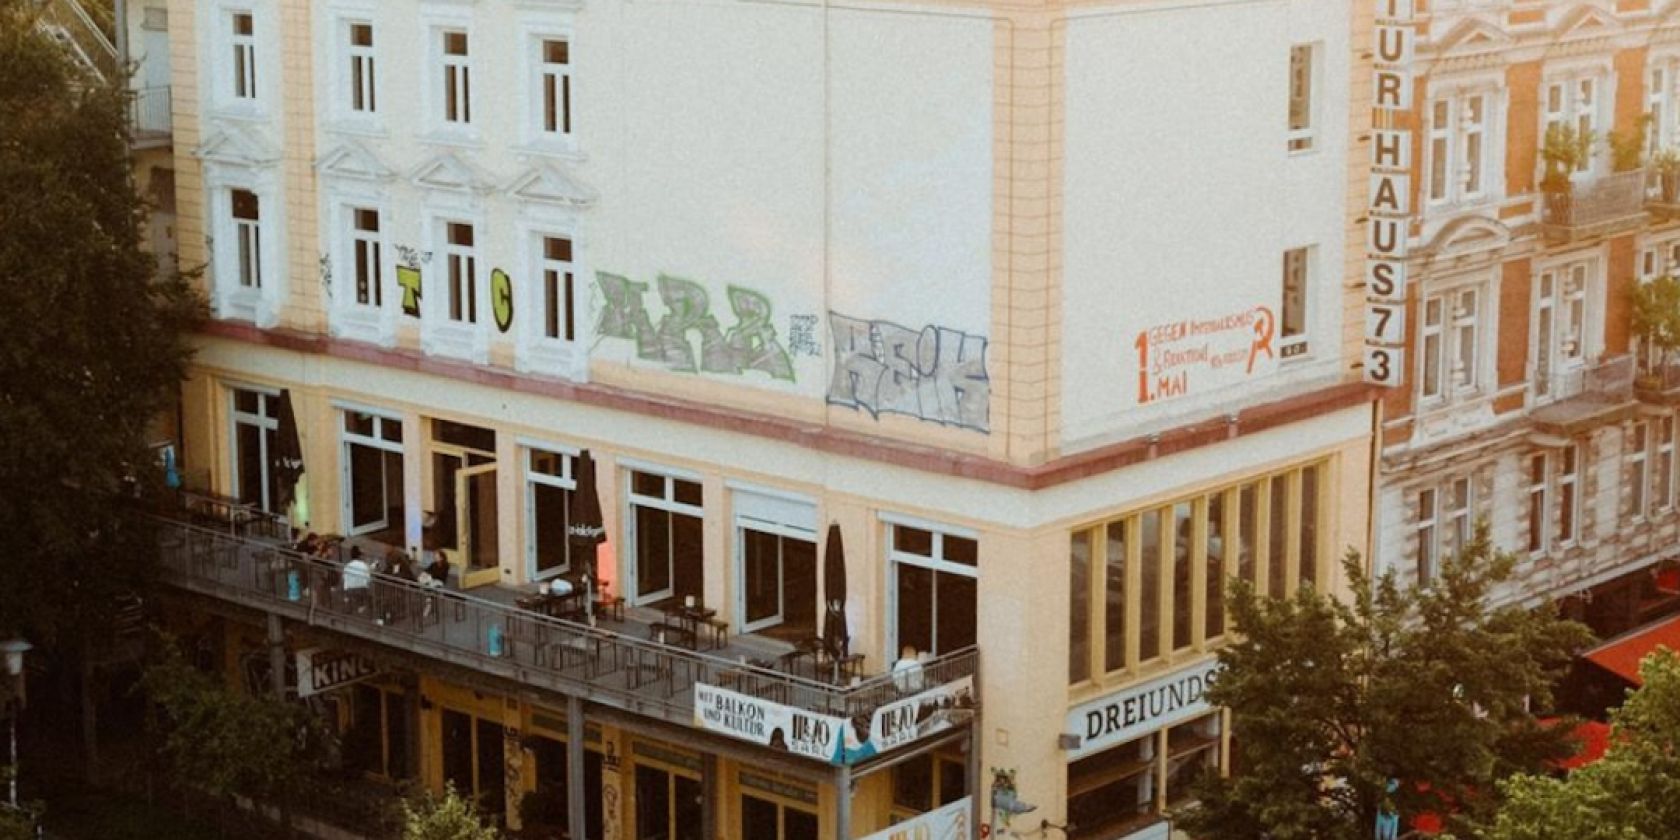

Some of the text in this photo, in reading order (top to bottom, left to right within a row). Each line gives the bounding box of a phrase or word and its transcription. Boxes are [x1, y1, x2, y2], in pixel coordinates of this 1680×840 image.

[1158, 371, 1187, 398] MAI
[704, 708, 721, 722] UND
[716, 694, 765, 720] BALKON
[1086, 667, 1217, 740] DREIUNDS
